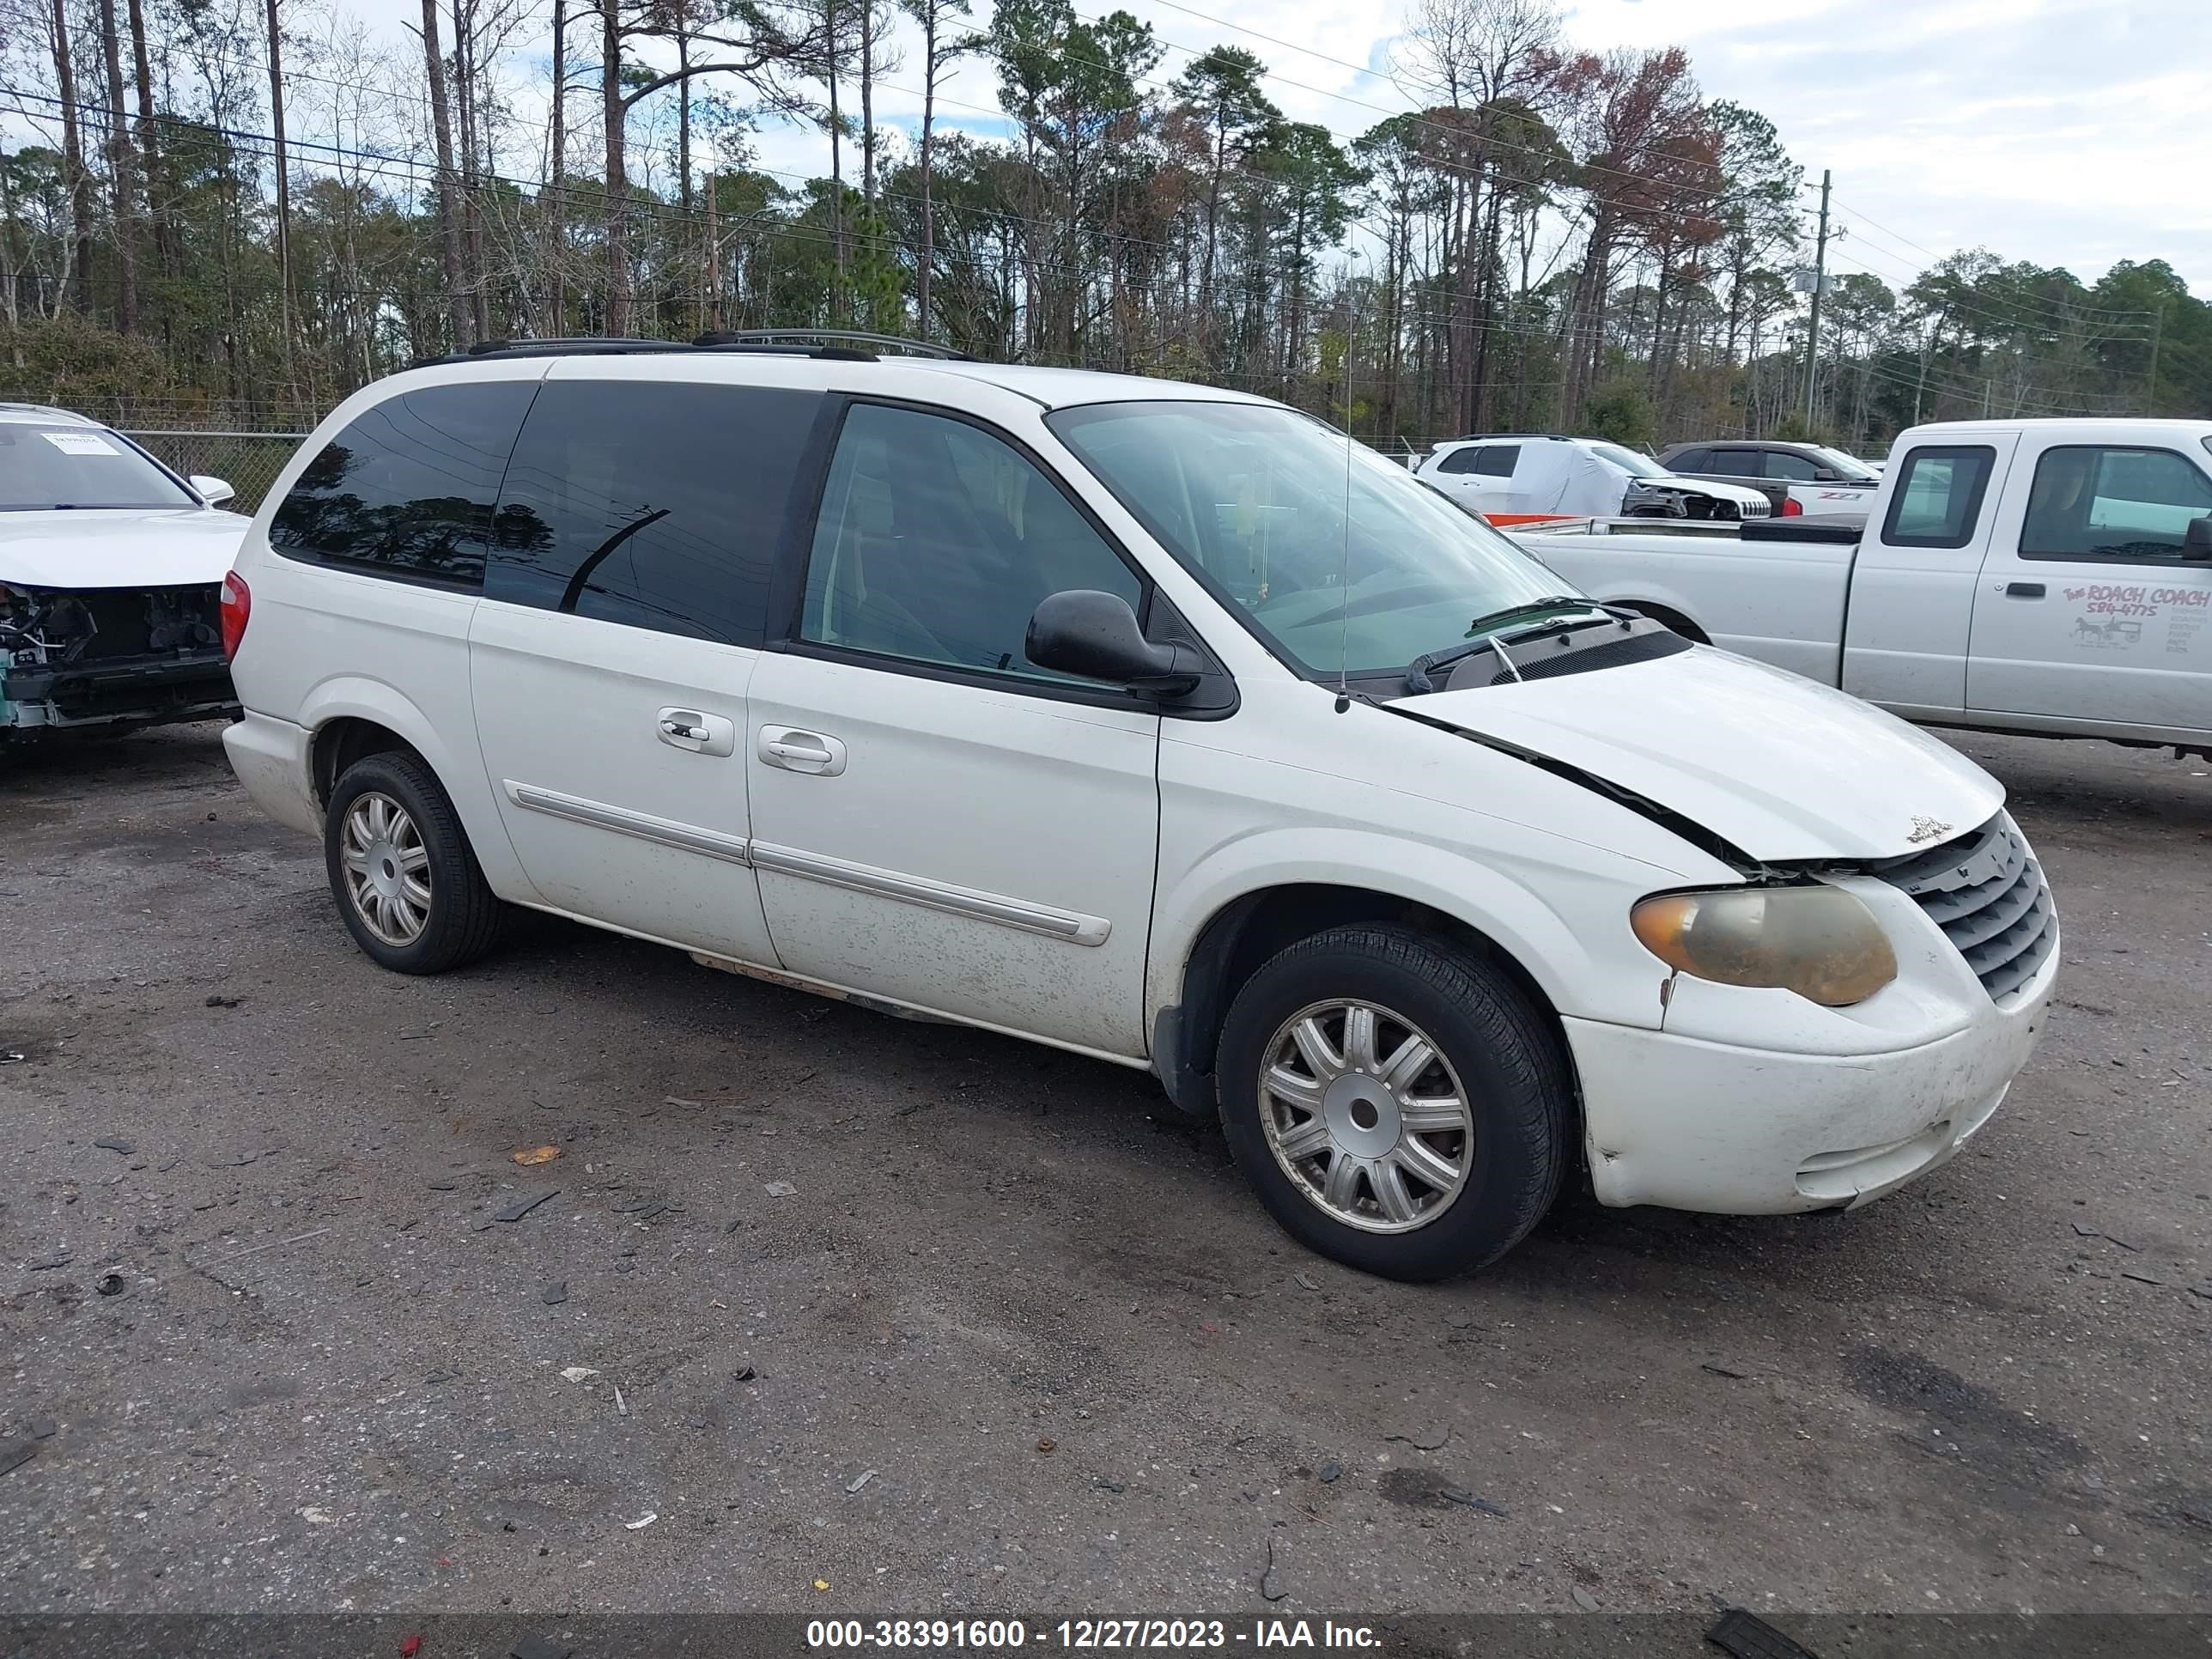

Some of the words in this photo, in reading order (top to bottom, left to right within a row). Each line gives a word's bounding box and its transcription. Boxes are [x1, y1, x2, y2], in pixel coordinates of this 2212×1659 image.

[1817, 491, 1863, 501] Z71
[2087, 585, 2147, 603] ROACH
[2150, 588, 2211, 607] COACH
[2087, 602, 2158, 617] 584-4775
